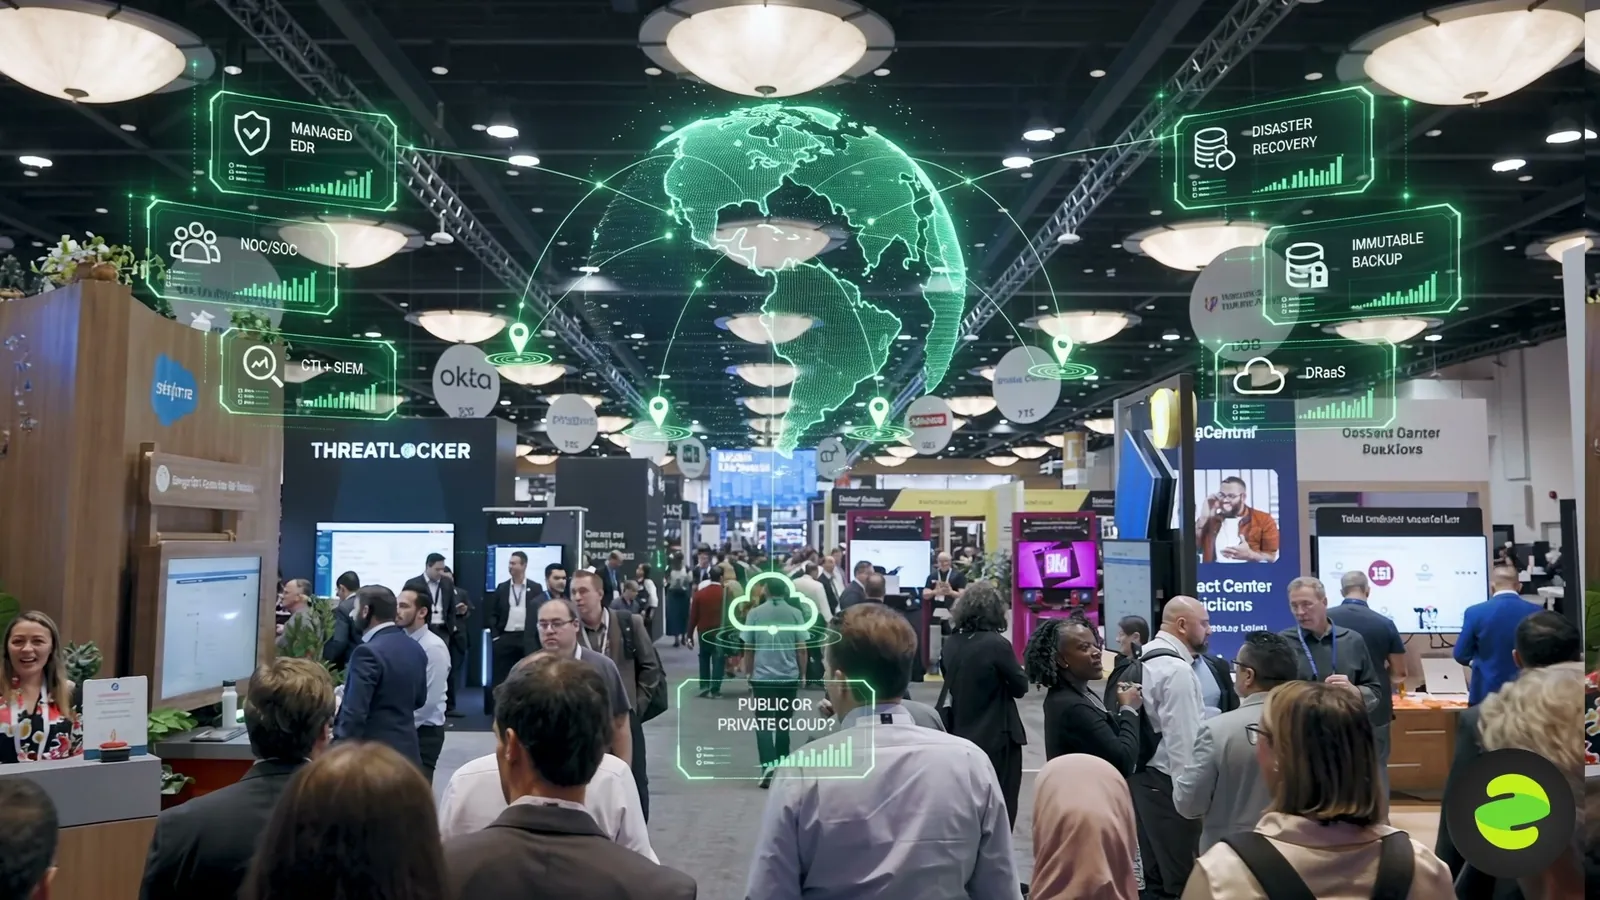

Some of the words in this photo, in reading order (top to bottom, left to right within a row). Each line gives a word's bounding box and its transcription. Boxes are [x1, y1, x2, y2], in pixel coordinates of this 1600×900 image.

[440, 365, 492, 390] okta
[311, 441, 471, 459] THREATLOCKER
[1223, 579, 1272, 593] Center
